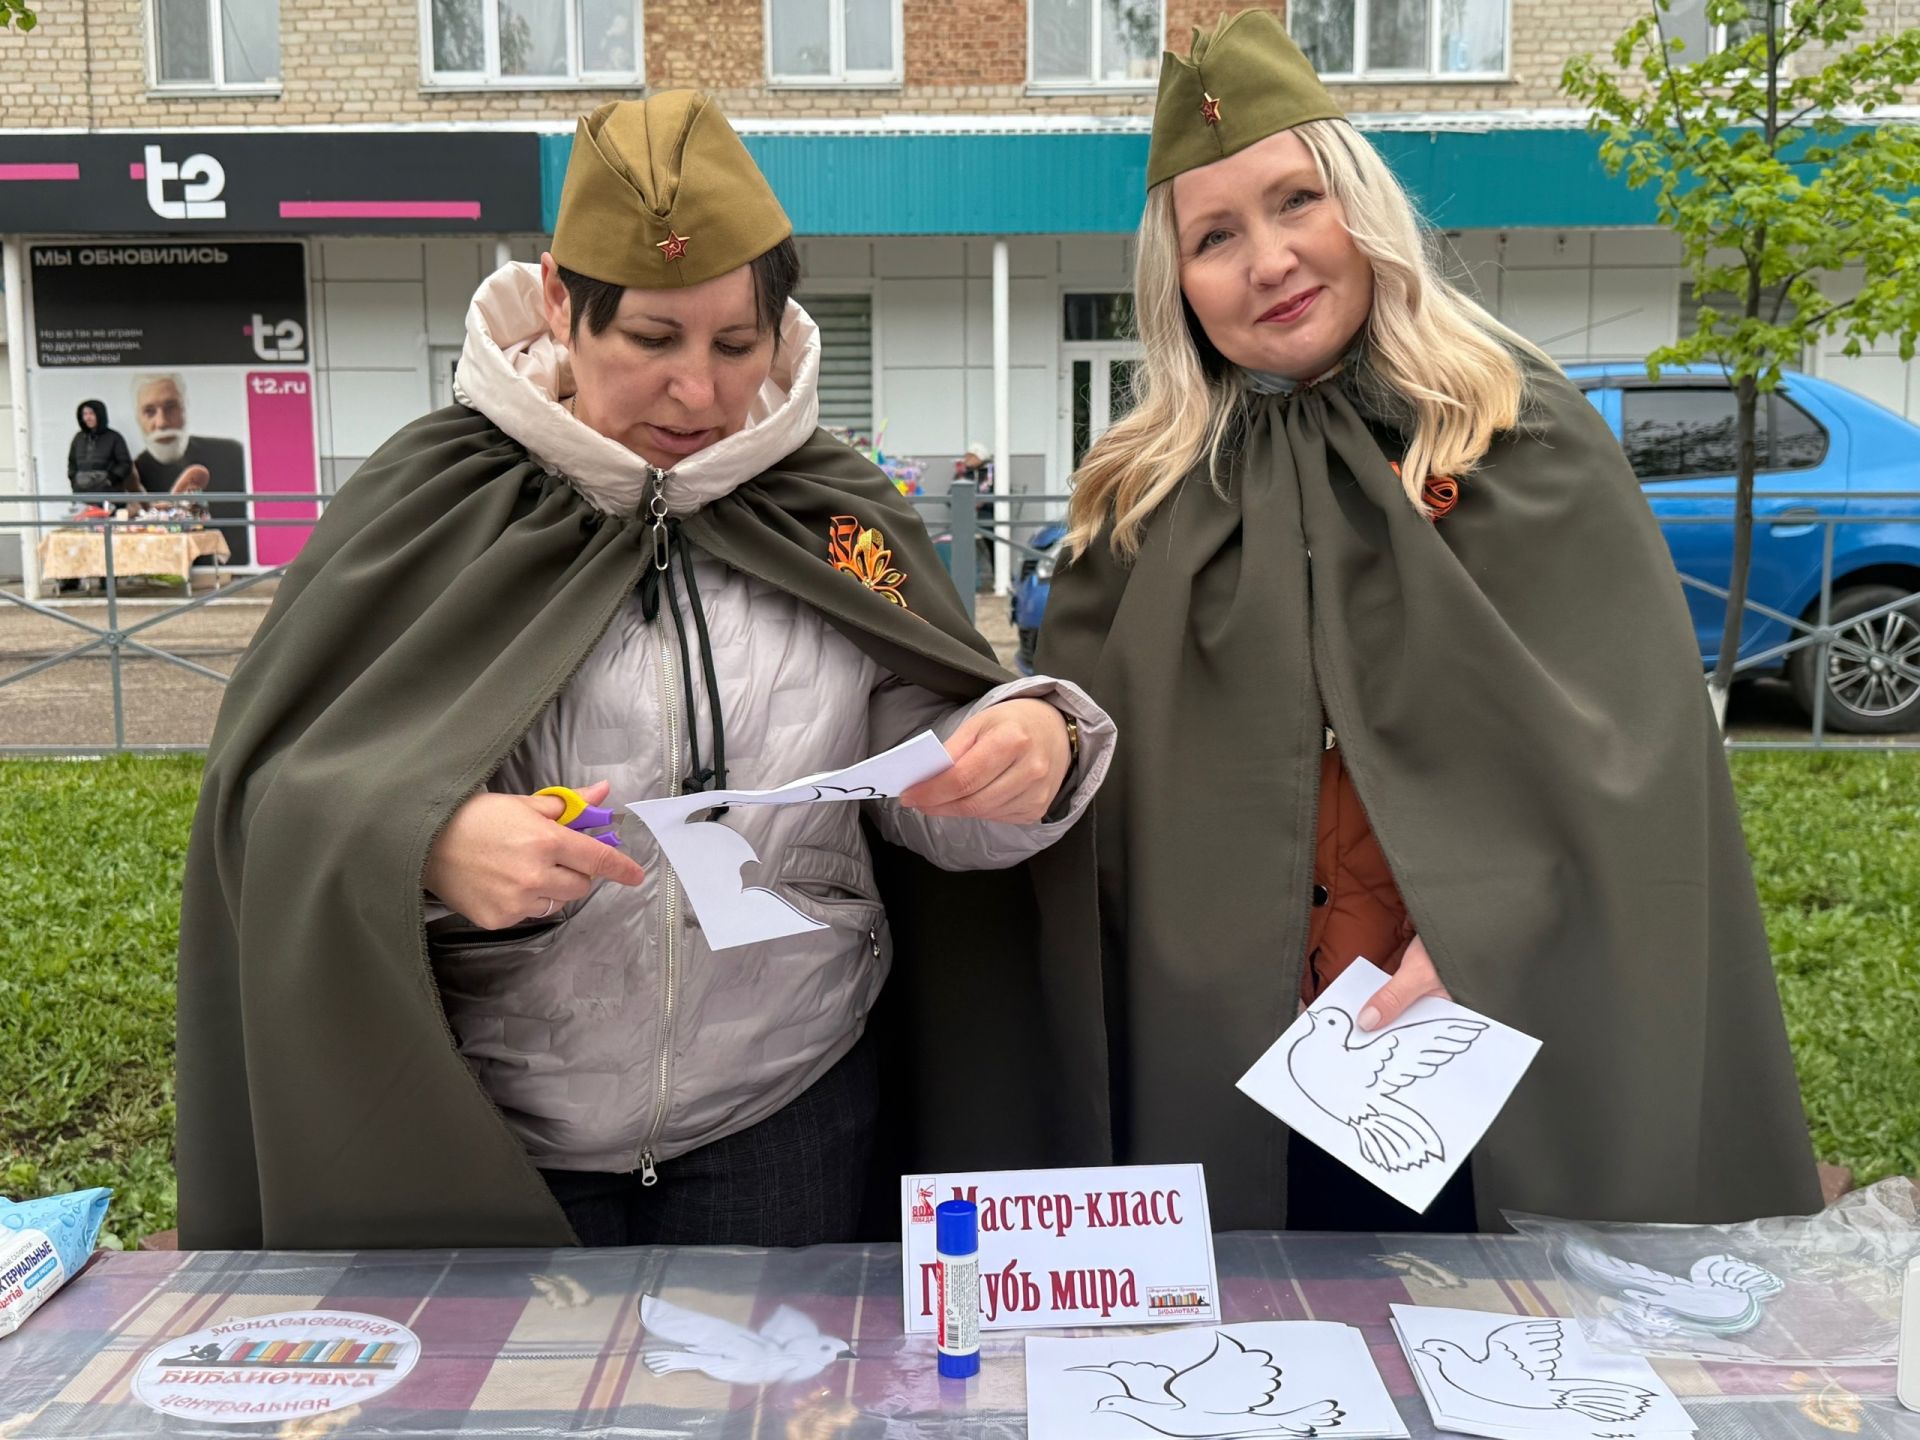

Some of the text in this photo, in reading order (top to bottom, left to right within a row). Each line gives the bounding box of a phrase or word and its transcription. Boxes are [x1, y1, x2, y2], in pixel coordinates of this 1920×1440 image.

[144, 144, 226, 219] t2
[34, 247, 229, 266] МЫ ОБНОВИЛИСЬ
[251, 313, 305, 361] t2
[252, 376, 307, 394] t2.ru
[919, 1259, 1041, 1322] Губь
[1048, 1267, 1140, 1318] мира
